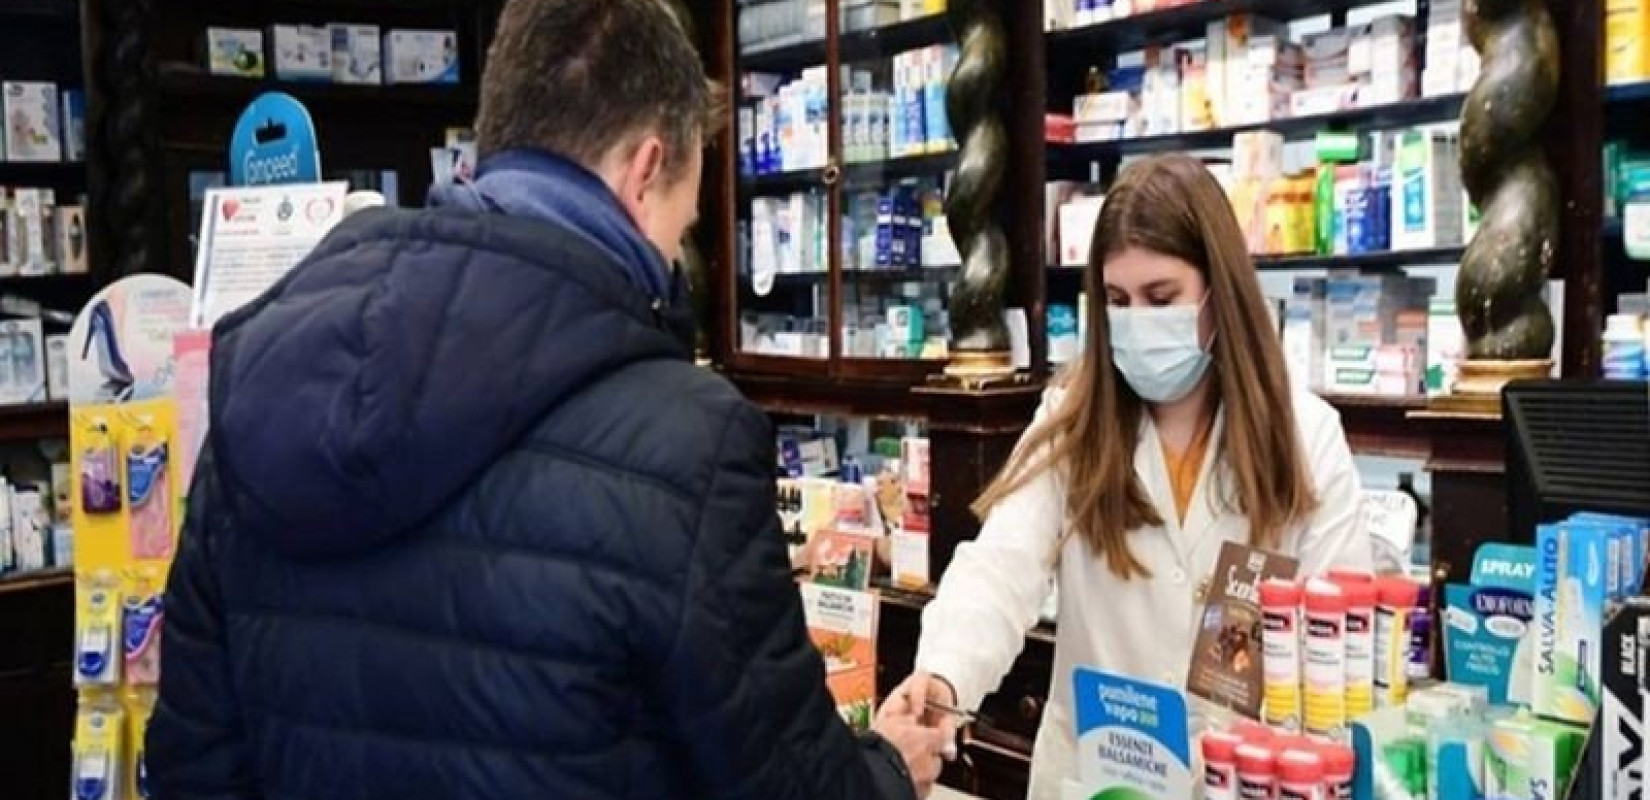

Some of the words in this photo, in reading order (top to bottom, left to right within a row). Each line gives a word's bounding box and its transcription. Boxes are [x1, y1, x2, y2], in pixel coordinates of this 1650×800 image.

[1481, 559, 1536, 578] SPRAY
[1620, 633, 1636, 675] BLACK
[1107, 731, 1153, 757] ESSENZE
[1098, 744, 1168, 778] BALSAMICHE
